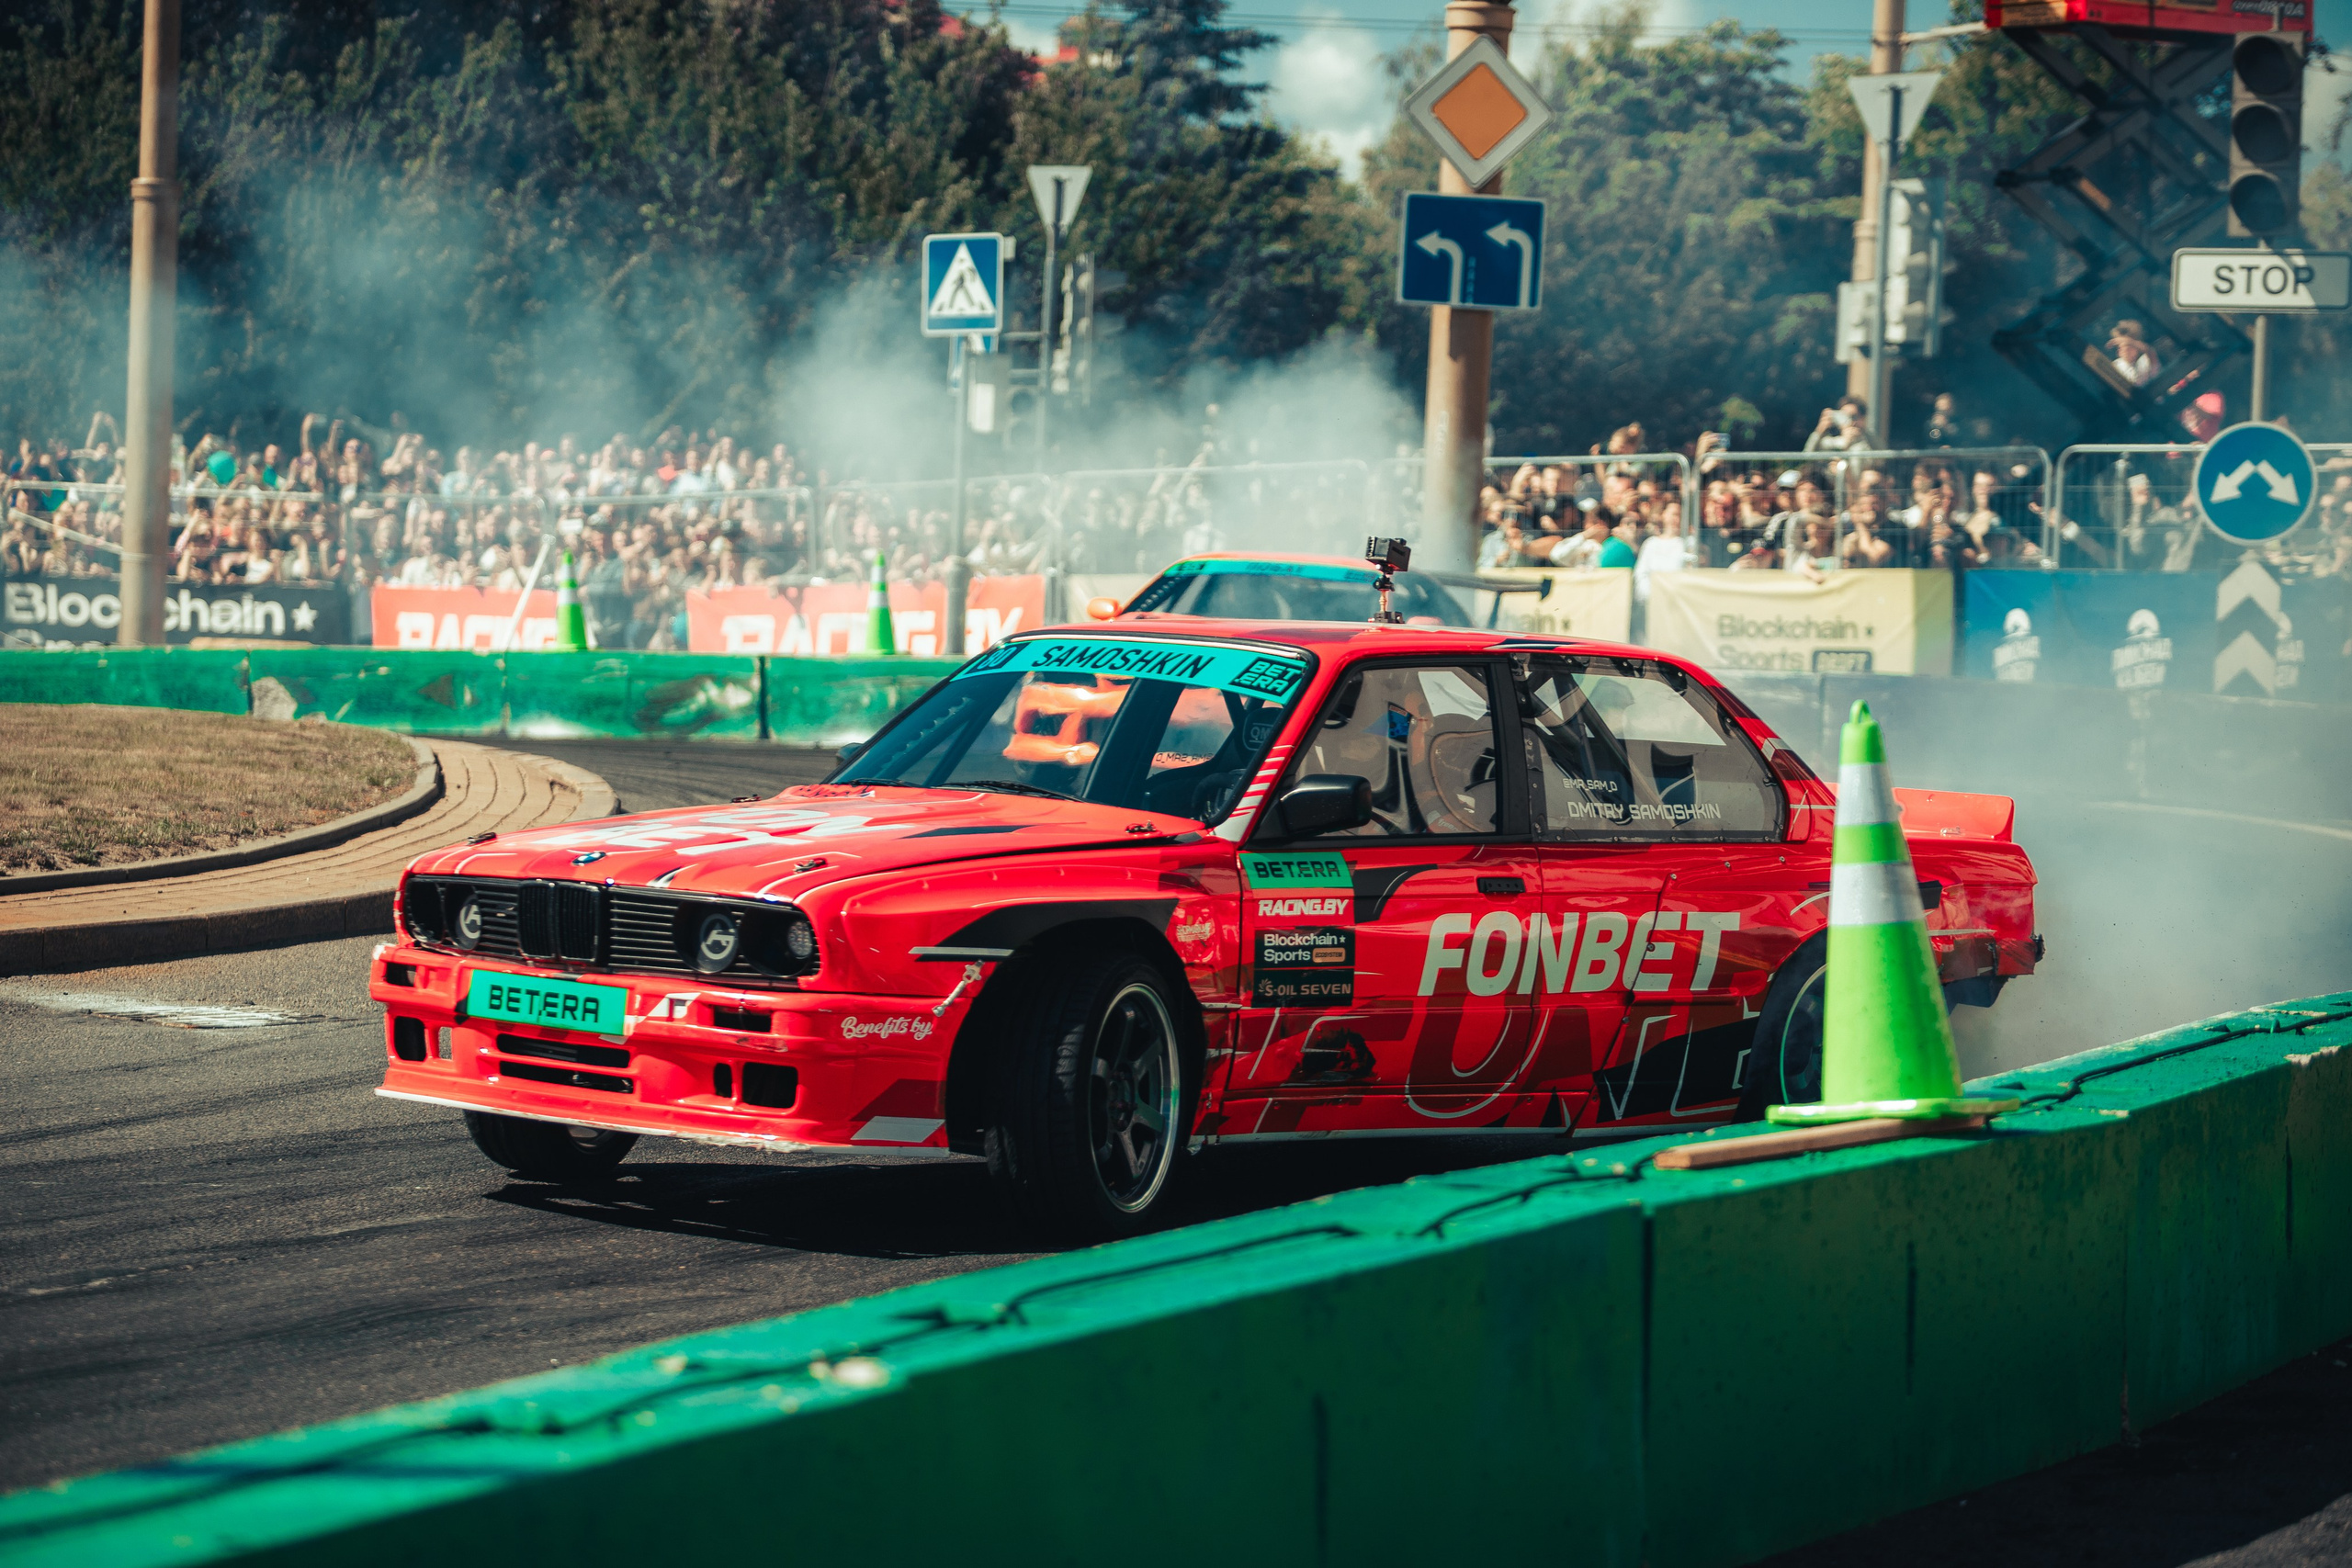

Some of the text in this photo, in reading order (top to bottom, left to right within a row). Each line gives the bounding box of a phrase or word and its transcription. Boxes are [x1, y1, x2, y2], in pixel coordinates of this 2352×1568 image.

[2213, 265, 2315, 295] STOP
[4, 581, 286, 636] Blochain
[1031, 646, 1216, 680] SAMOSHKIN
[1248, 660, 1303, 681] BET
[1567, 801, 1722, 820] DMITRY SAMOSHKIN
[1258, 898, 1349, 917] RACING.BY
[1263, 932, 1338, 946] Blockchain
[1263, 949, 1311, 964] Sports
[1417, 911, 1741, 997] FONBET
[1265, 983, 1351, 997] S-OIL SEVEN
[841, 1016, 933, 1041] Benefits by
